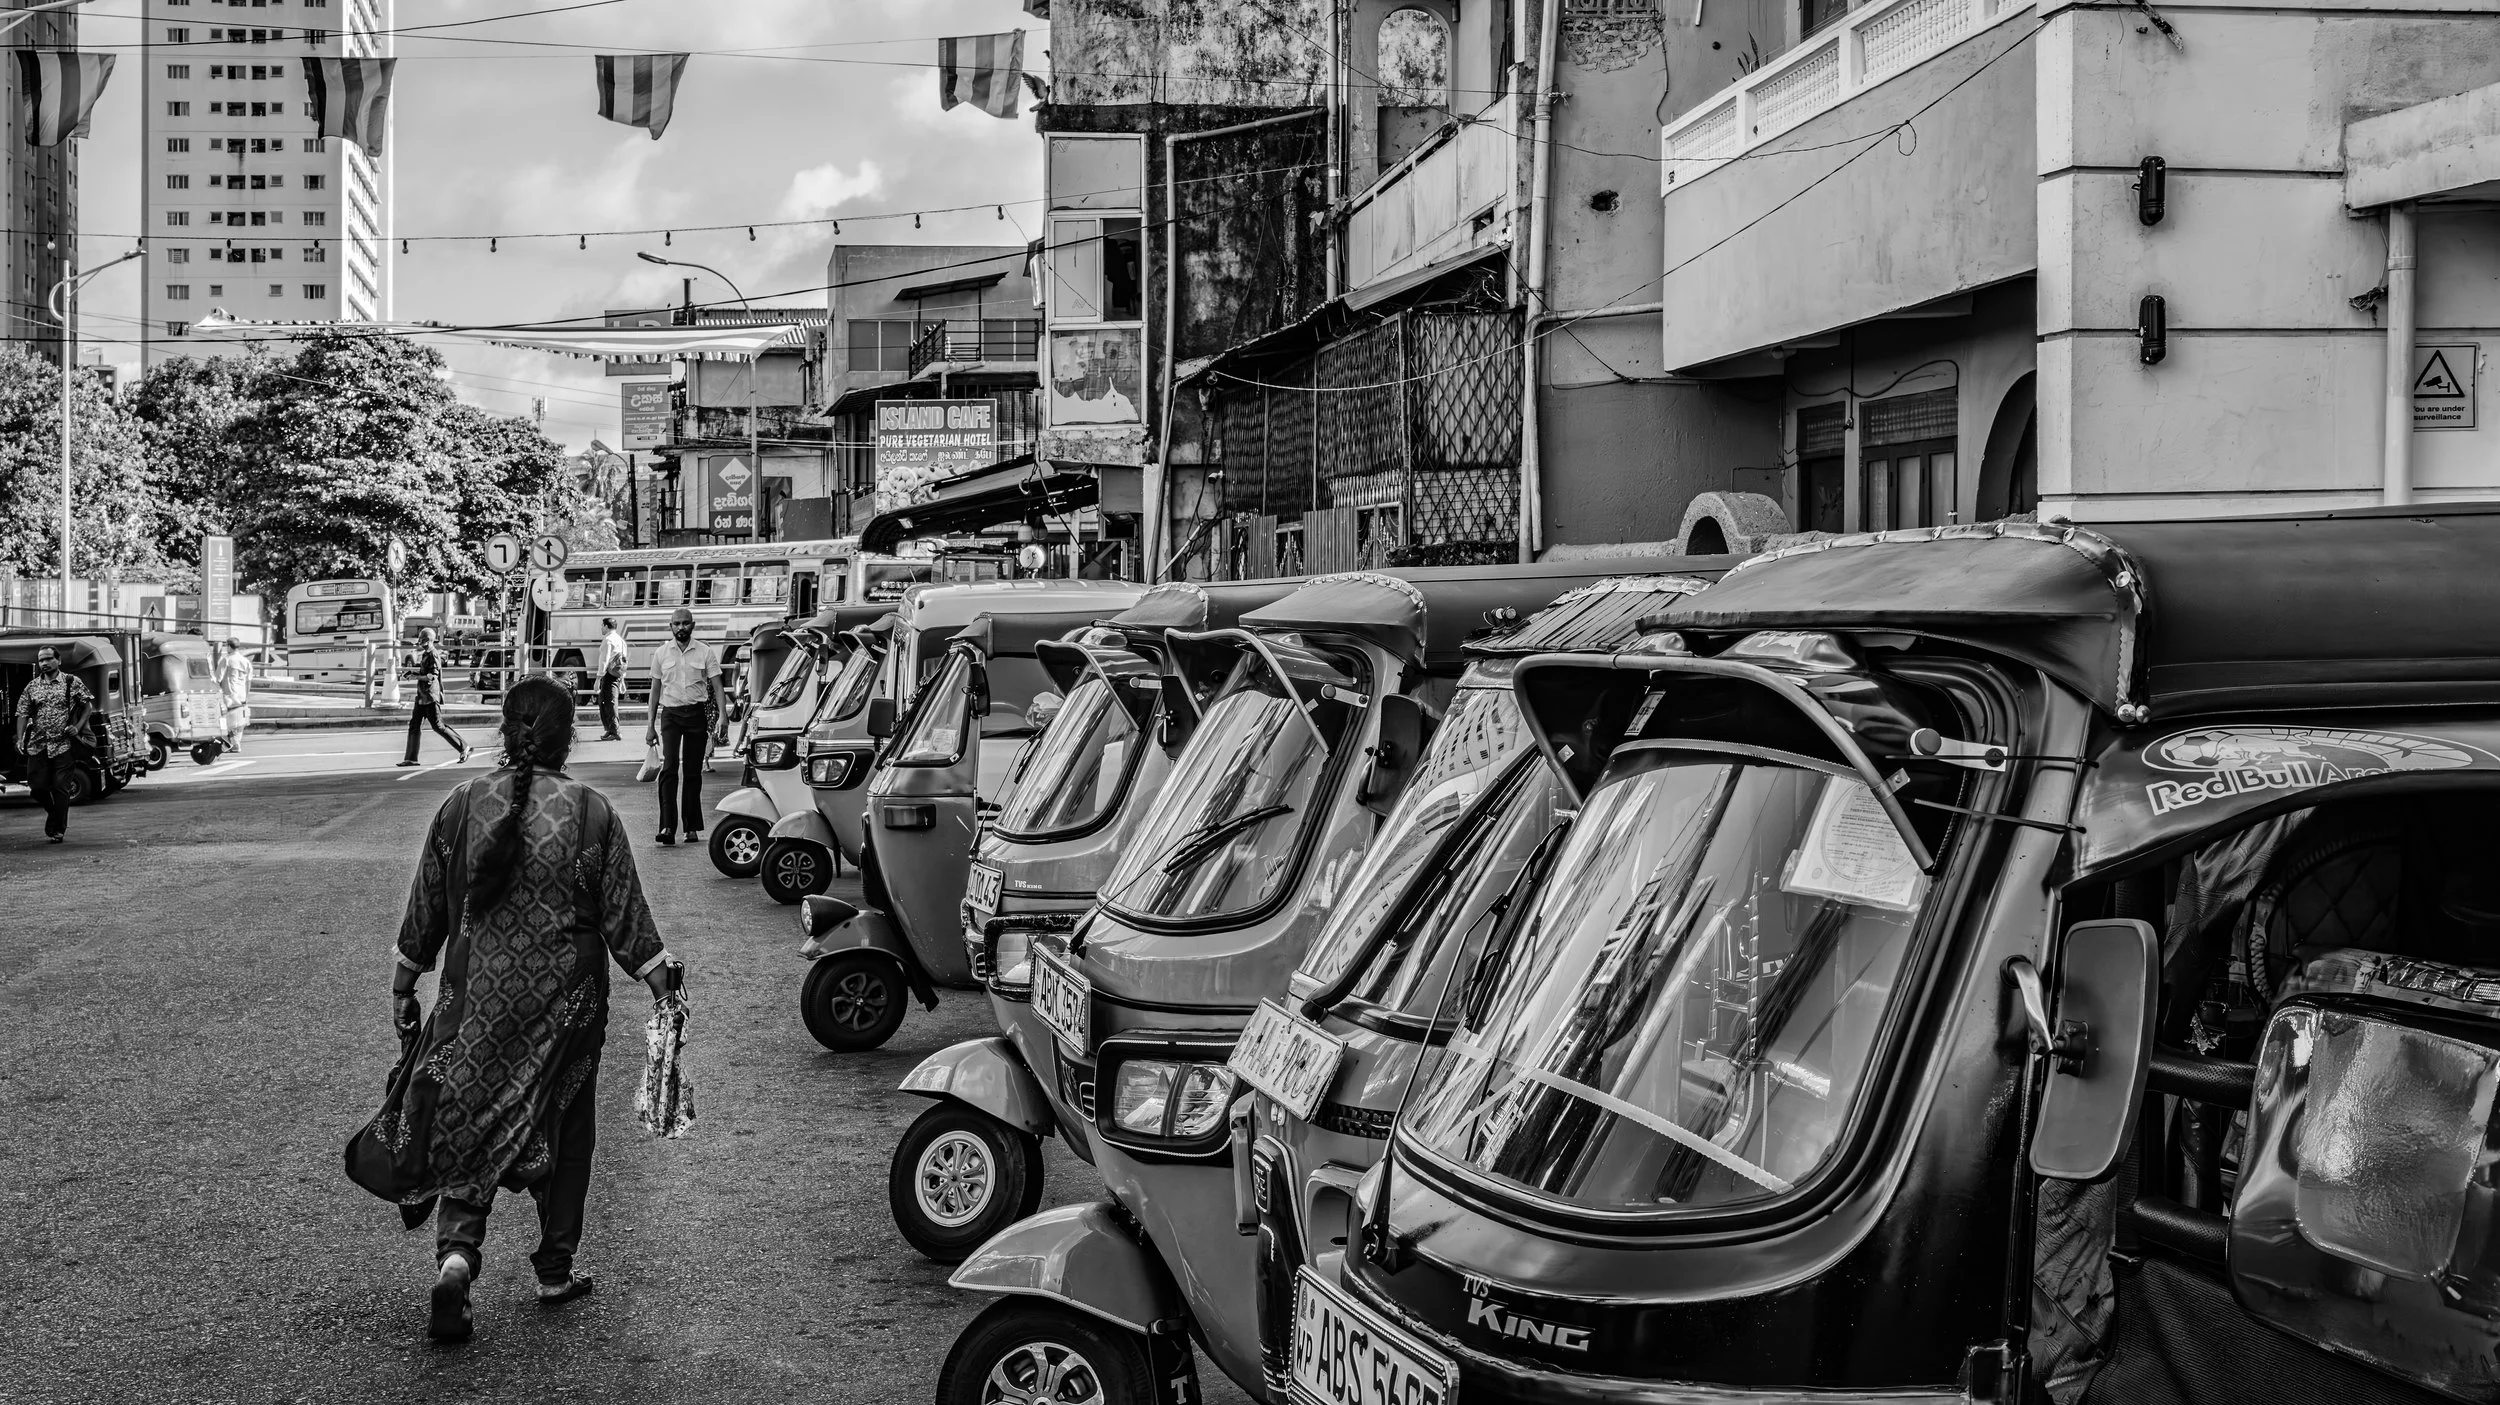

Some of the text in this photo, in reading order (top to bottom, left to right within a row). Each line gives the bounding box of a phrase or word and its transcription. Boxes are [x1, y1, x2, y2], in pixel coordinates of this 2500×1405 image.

[880, 405, 991, 430] ISLAND CAFE
[880, 433, 992, 448] PURE VEGETARIAN HOTEL
[1015, 880, 1027, 889] TVS
[1463, 1273, 1493, 1298] TVS
[1468, 1297, 1592, 1352] KING
[1297, 1324, 1313, 1377] WP
[1316, 1307, 1369, 1405] ABS
